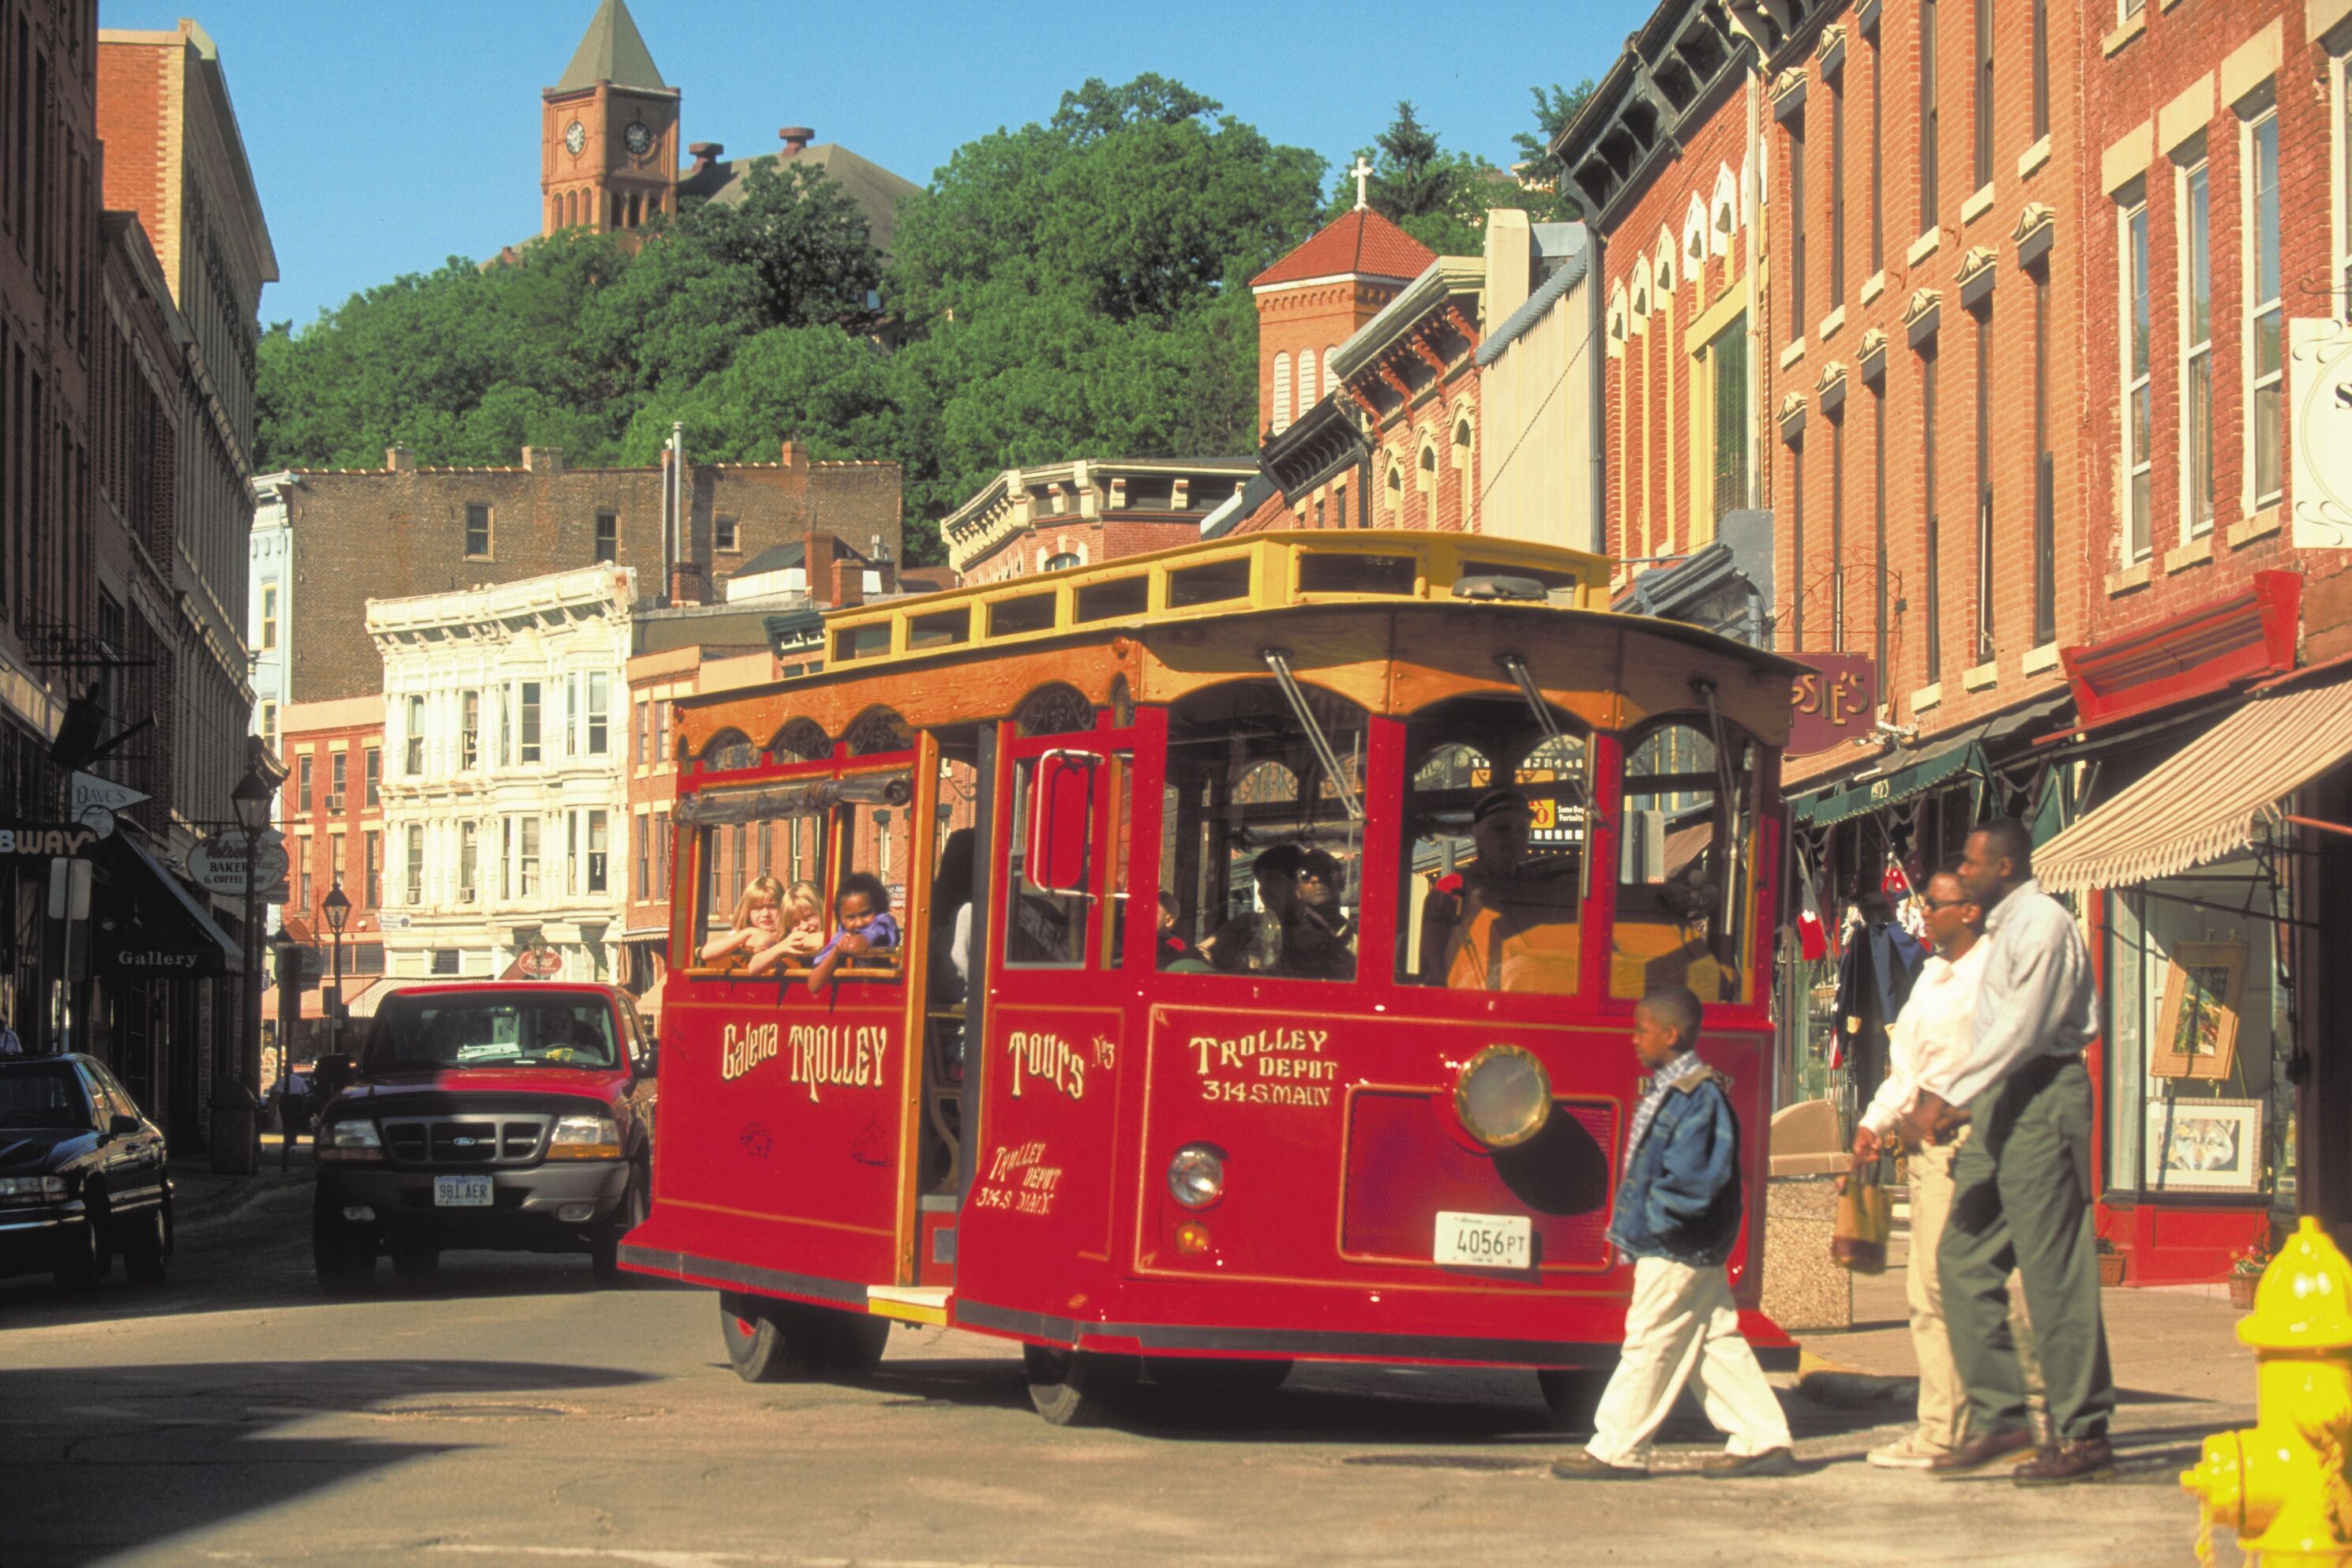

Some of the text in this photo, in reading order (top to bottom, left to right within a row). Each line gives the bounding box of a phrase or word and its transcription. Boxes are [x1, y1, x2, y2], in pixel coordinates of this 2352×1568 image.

[77, 786, 127, 804] DAVE'S
[1559, 813, 1584, 822] Portraits
[118, 951, 197, 968] Gallery
[722, 1022, 887, 1103] Galena TROLLEY
[1188, 1027, 1328, 1076] TROLLEY
[1259, 1056, 1338, 1080] DEPOT
[1202, 1080, 1246, 1102] 314
[988, 1142, 1046, 1182] TROLLEY
[1022, 1167, 1062, 1191] DEPOT
[439, 1184, 487, 1199] 981 AER
[975, 1187, 1001, 1206] 314
